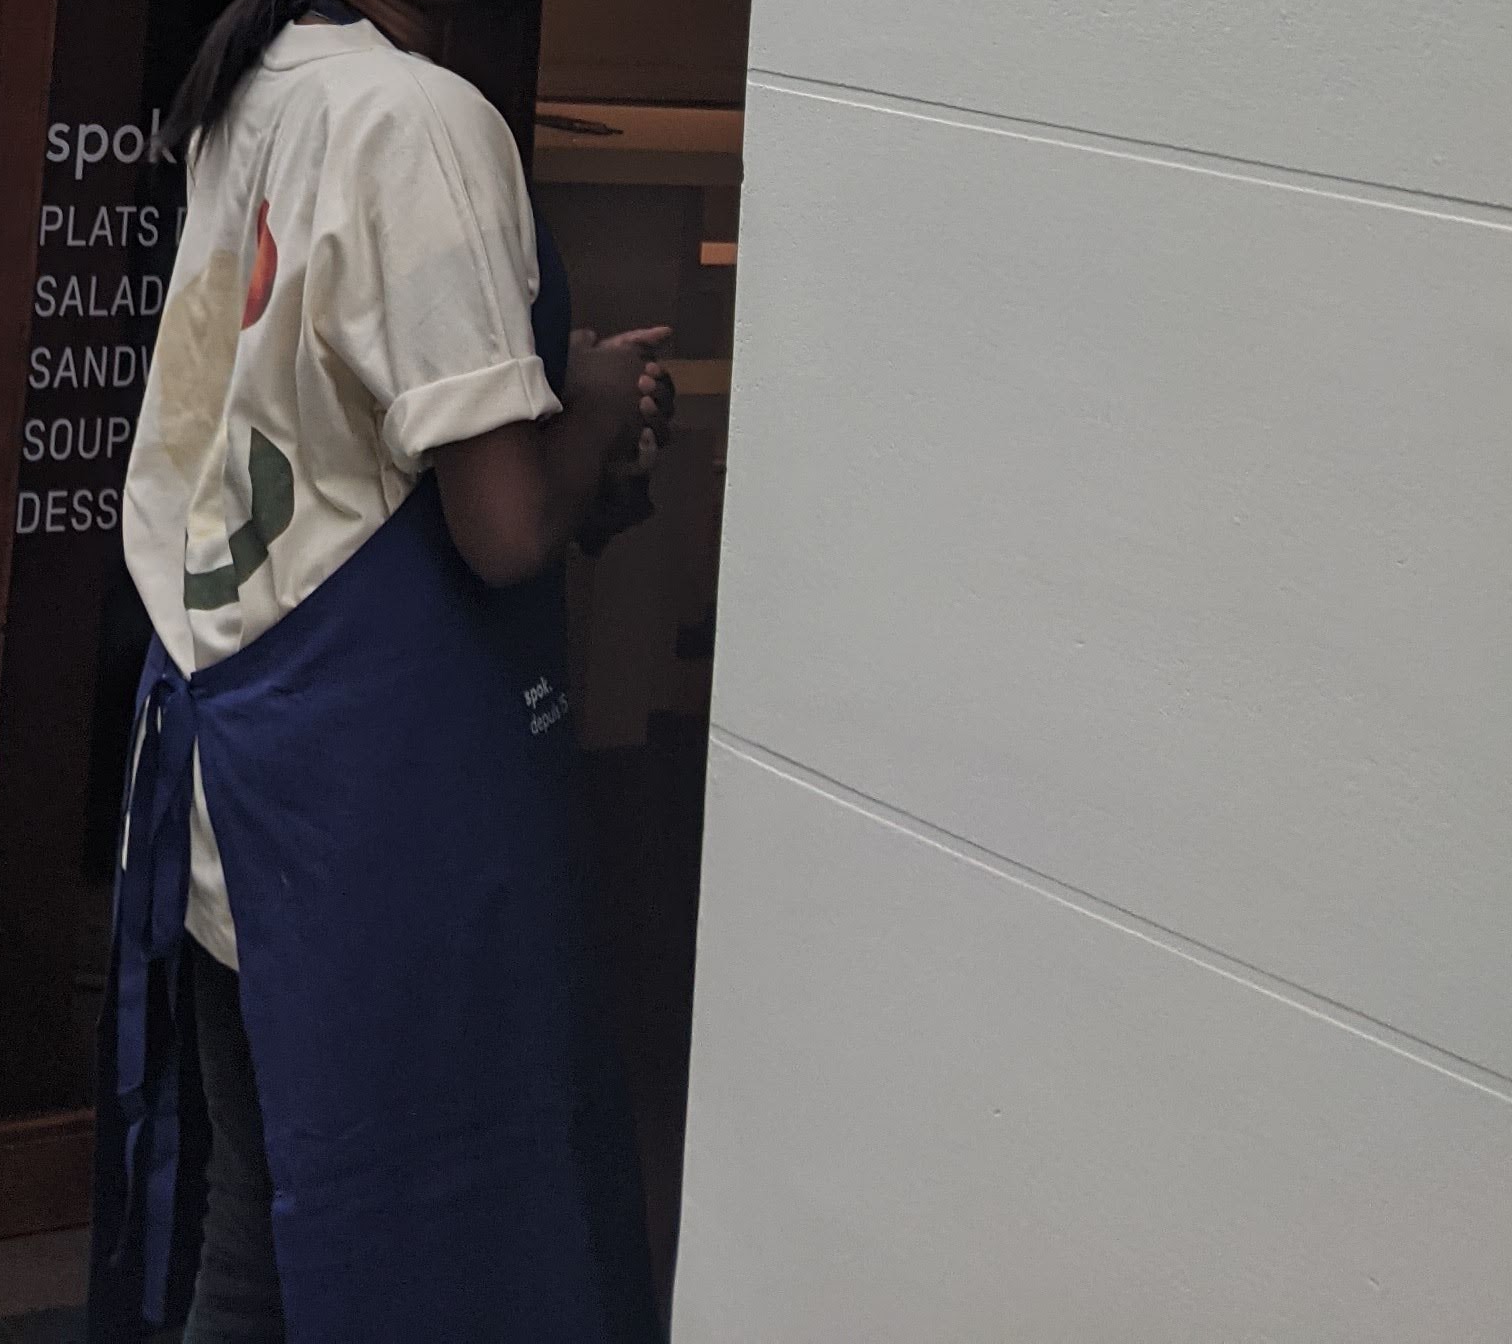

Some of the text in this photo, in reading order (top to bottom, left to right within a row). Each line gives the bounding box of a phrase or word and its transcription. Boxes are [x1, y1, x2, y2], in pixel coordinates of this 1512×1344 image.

[39, 205, 160, 248] PLATS
[34, 275, 163, 318] SALAD
[22, 417, 131, 462] SOUP
[15, 488, 119, 535] DESS
[524, 676, 553, 709] spok.
